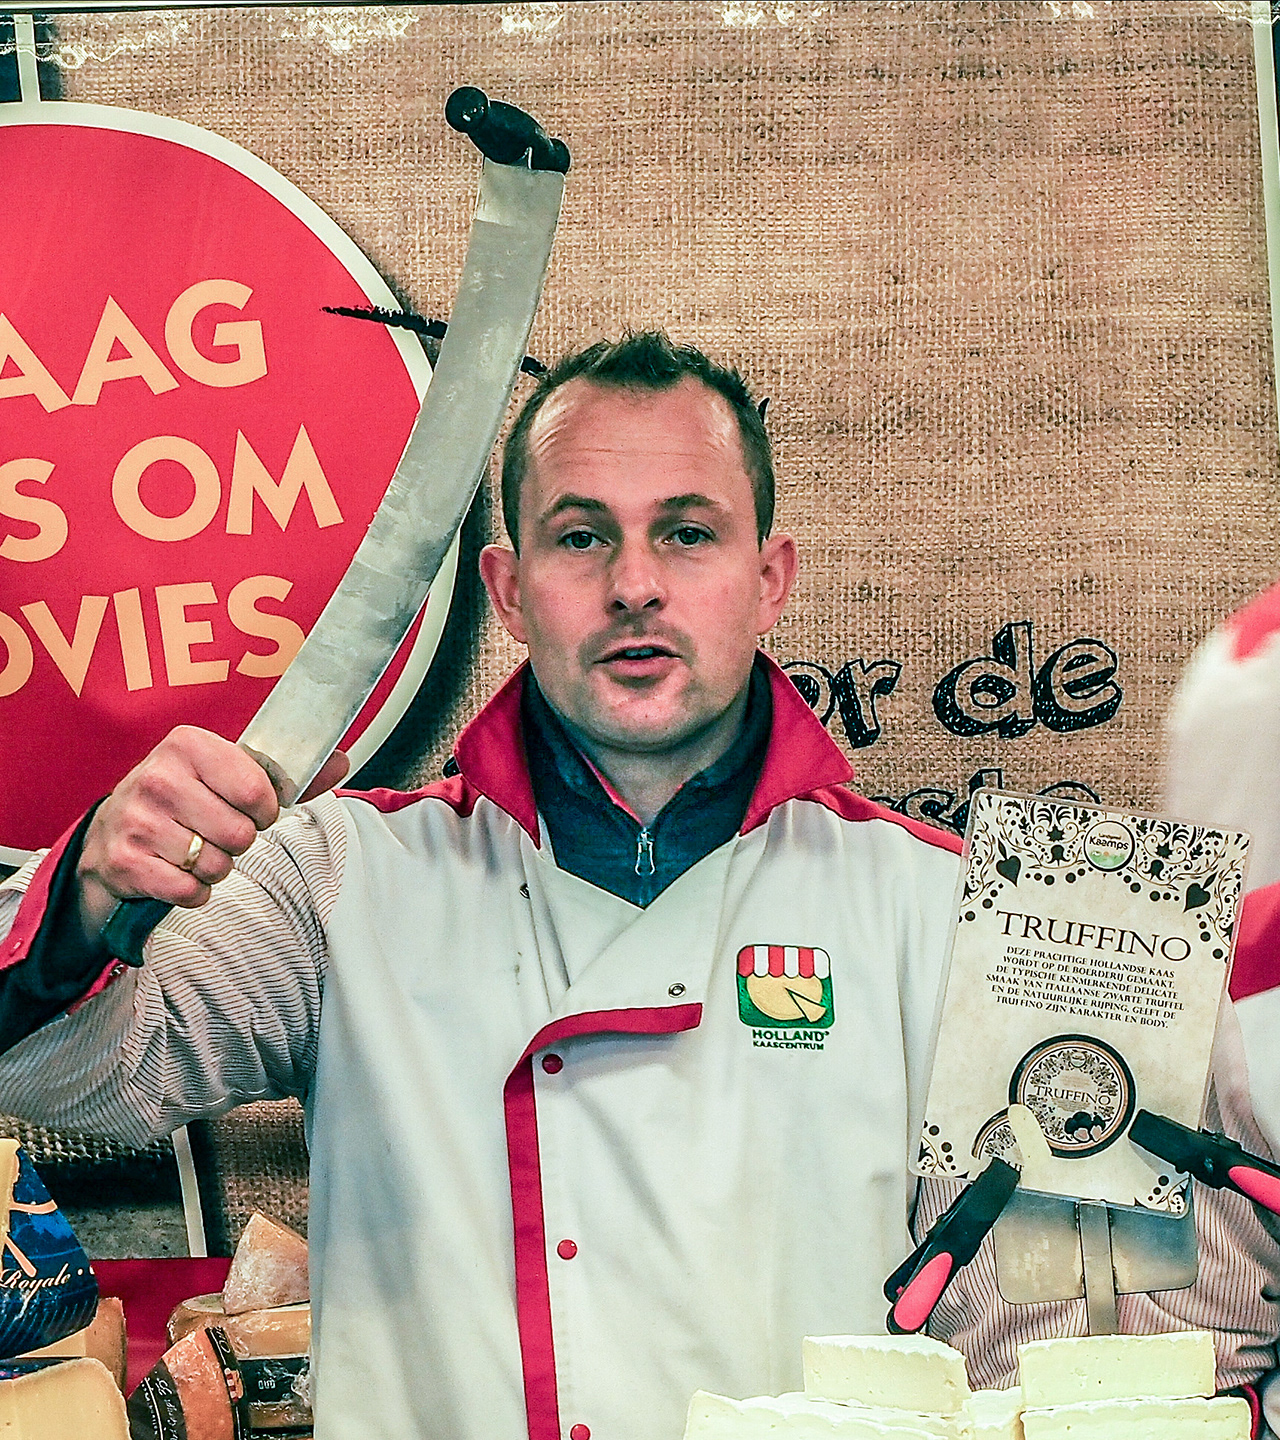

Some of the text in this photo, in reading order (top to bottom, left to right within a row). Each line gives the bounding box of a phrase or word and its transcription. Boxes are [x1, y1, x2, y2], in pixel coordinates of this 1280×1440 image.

[112, 424, 344, 542] OM
[932, 620, 1123, 738] de
[1089, 835, 1129, 851] Kaamps
[996, 910, 1191, 961] TRUFFINO
[1003, 955, 1039, 968] WORDT
[1041, 961, 1055, 970] OP
[1057, 964, 1070, 973] DE
[1006, 946, 1175, 978] DEZE PRACHTIGE HOLLANDSE KAAS
[986, 974, 1184, 1011] SMAAK VAN ITALIAANSE ZWARTE TRUFFEL
[996, 965, 1178, 999] DE TYPISCHE KENMERKENDE DELICATE
[991, 984, 1005, 993] EN
[1007, 987, 1020, 996] DE
[1023, 989, 1088, 1006] NATUURLIJKE
[1163, 1011, 1177, 1020] DE
[996, 995, 1043, 1009] TRUFFINO
[1045, 1003, 1067, 1013] ZIJN
[1069, 1007, 1121, 1022] KARAKTER
[1124, 1015, 1137, 1023] EN
[752, 1029, 826, 1042] HOLLAND
[753, 1040, 824, 1051] KAASCENTRUM
[1033, 1085, 1112, 1107] TRUFFINO
